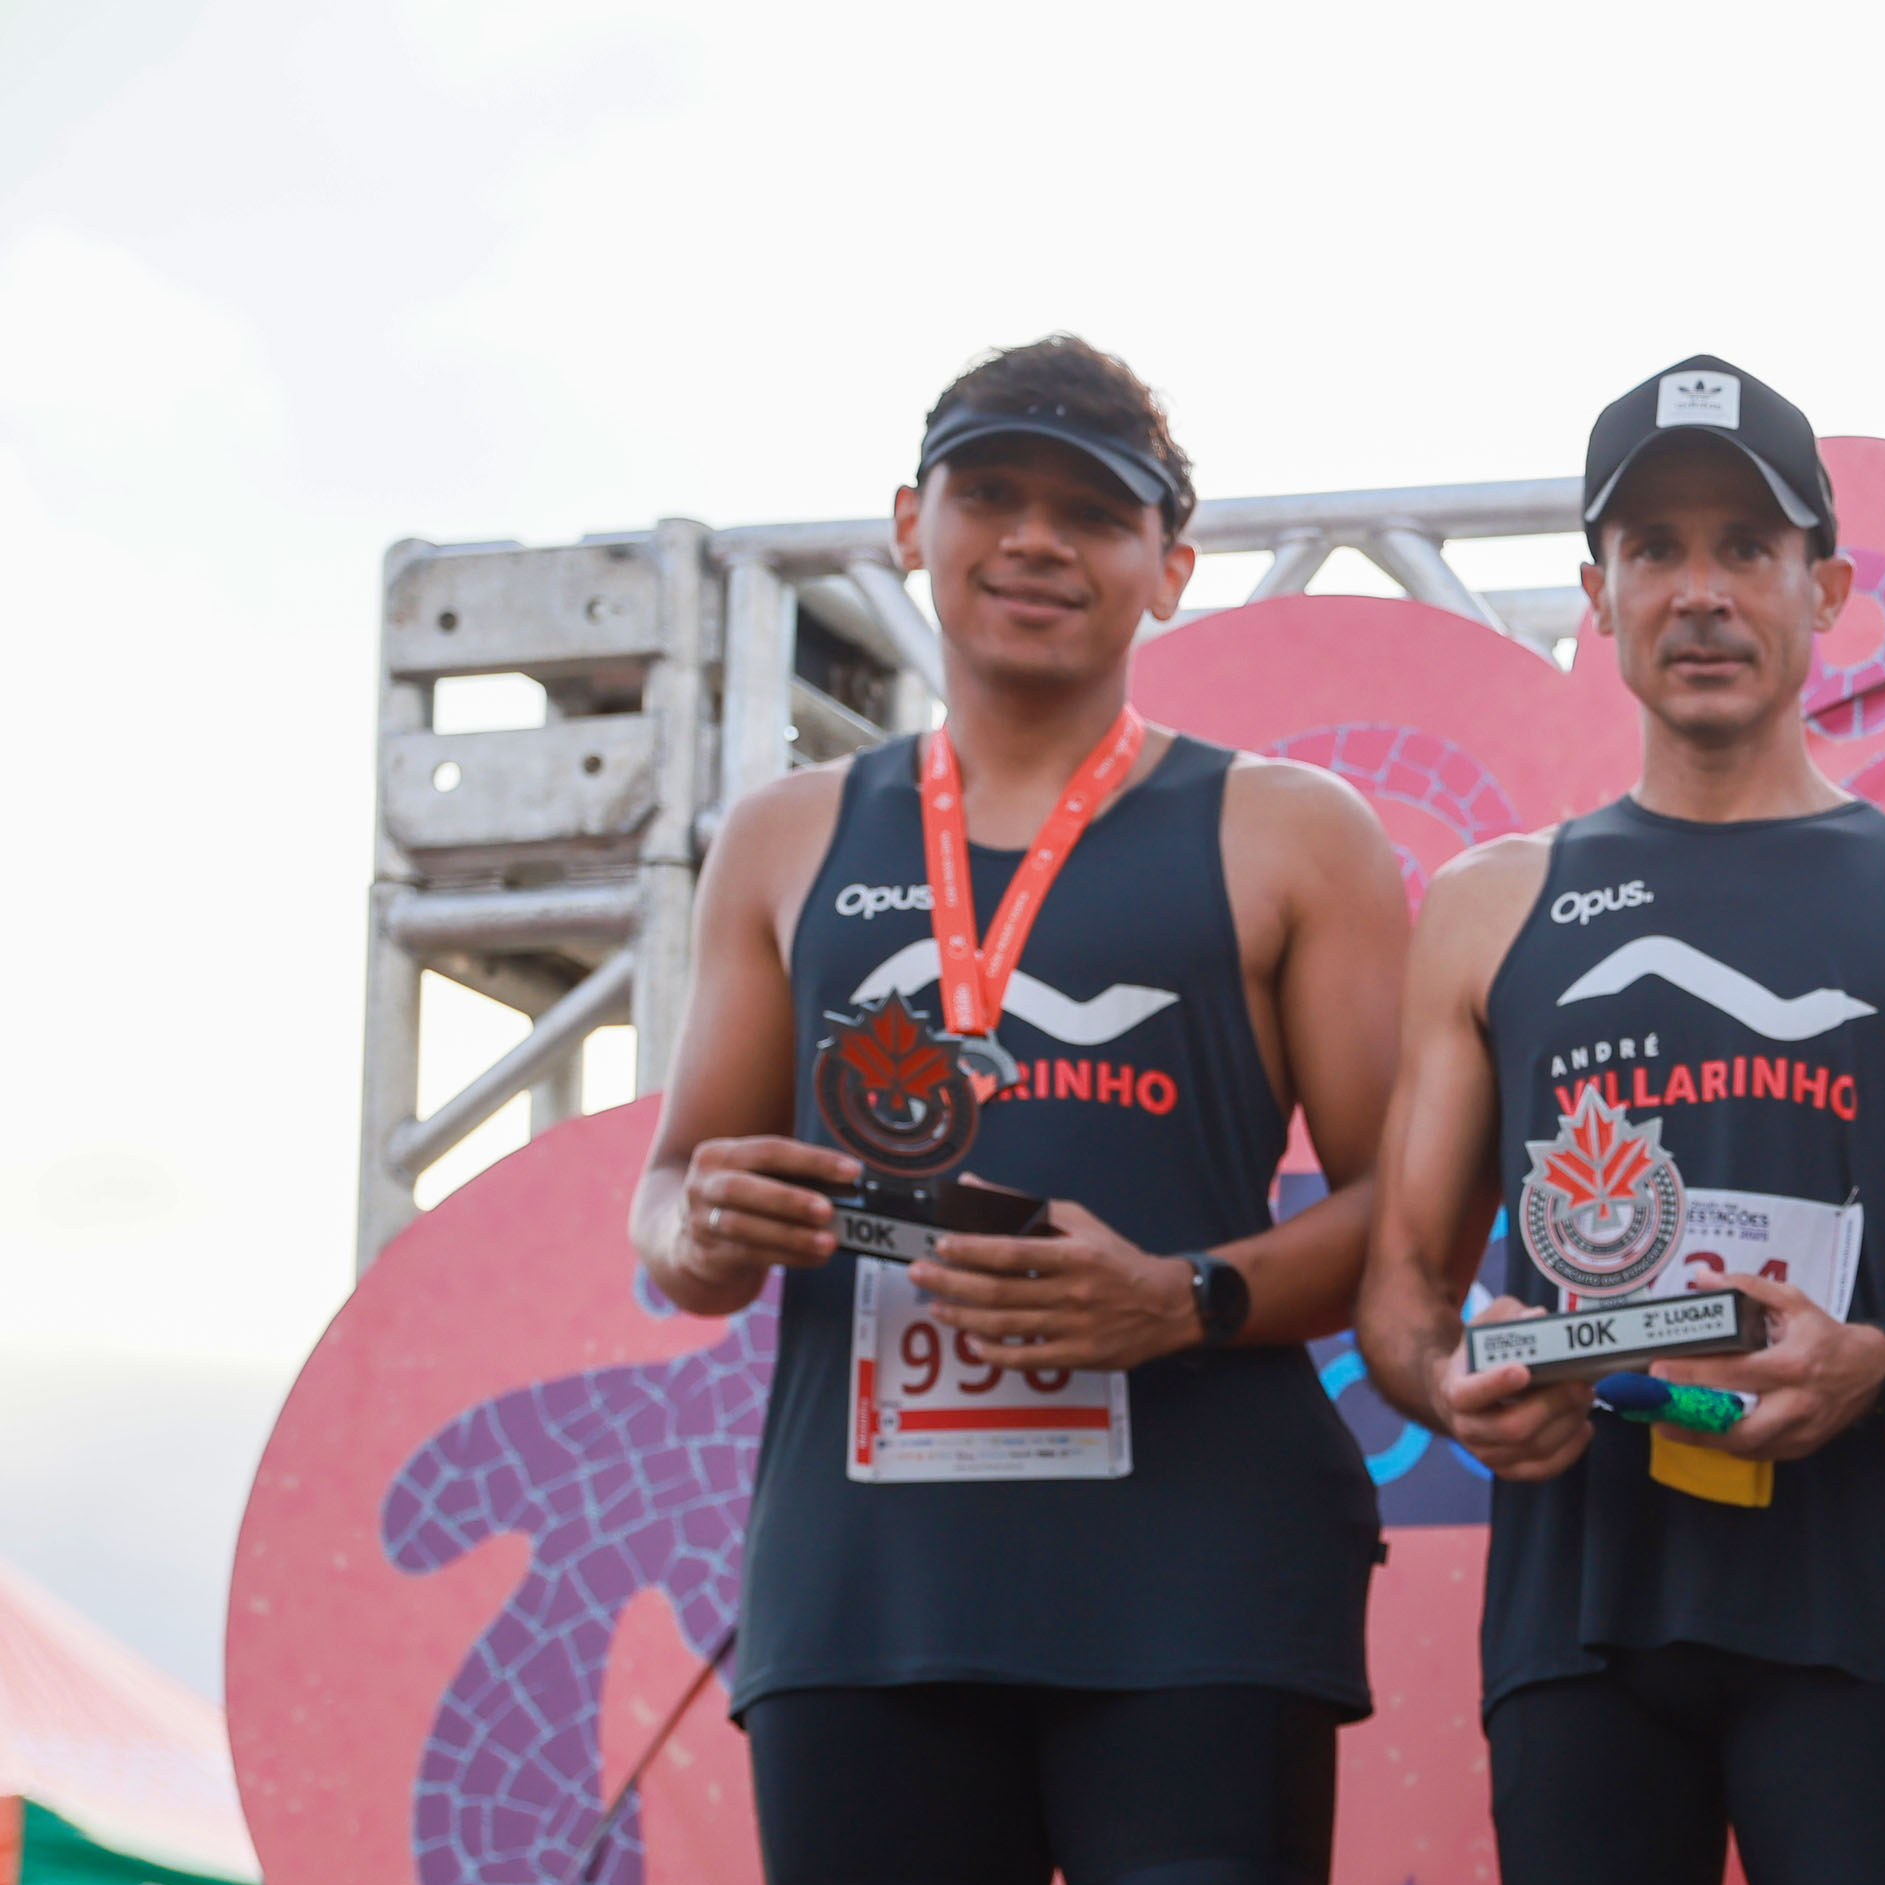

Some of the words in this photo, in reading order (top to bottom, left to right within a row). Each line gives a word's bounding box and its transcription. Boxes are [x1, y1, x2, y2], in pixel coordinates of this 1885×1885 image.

[835, 884, 936, 920] Opus
[1551, 1032, 1660, 1078] ANDRÉ
[844, 1216, 896, 1249] 10K
[1664, 1303, 1725, 1327] LUGAR
[1565, 1318, 1618, 1350] 10K
